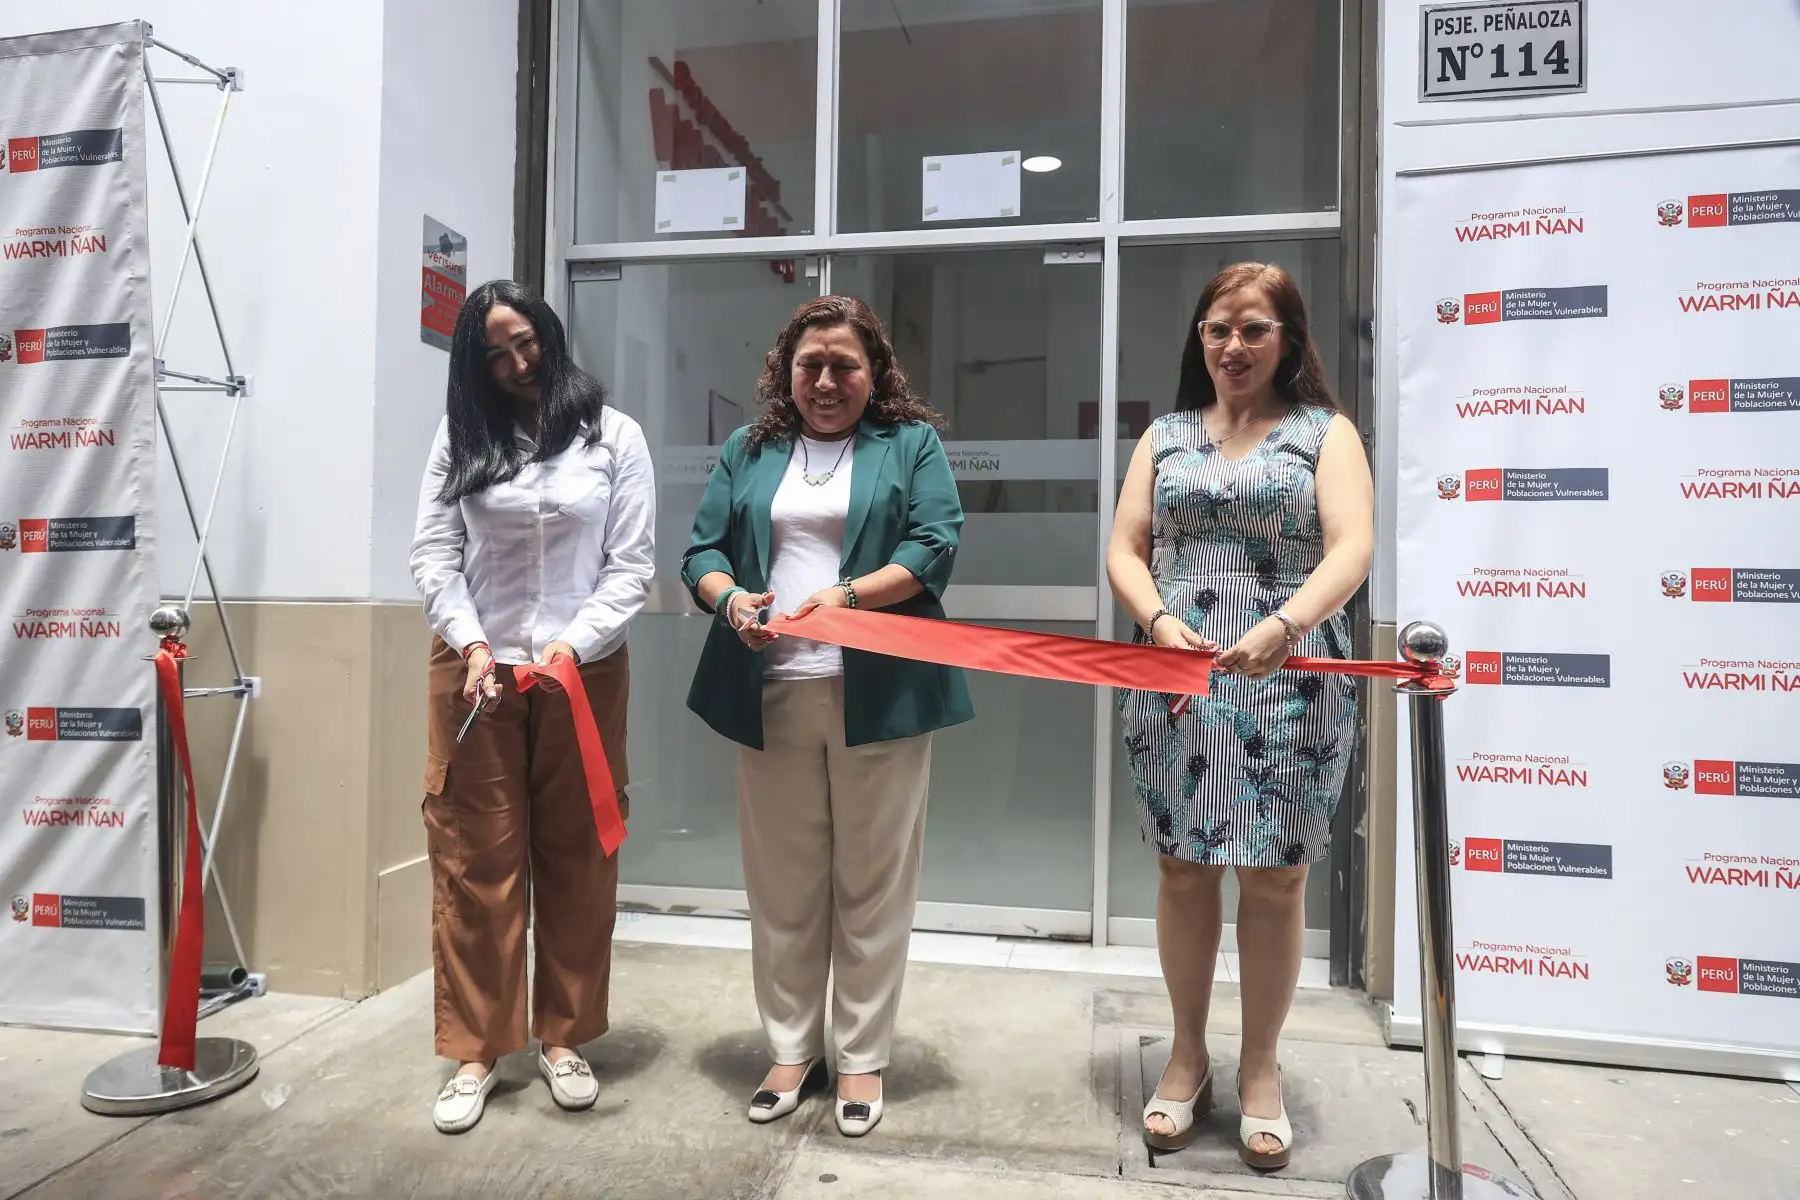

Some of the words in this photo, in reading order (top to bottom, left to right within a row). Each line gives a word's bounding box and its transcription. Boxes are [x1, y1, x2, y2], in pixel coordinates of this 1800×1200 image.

[1434, 16, 1478, 36] PSJE.
[1484, 8, 1572, 32] PEÑALOZA
[41, 136, 72, 146] Ministerio
[12, 146, 36, 160] PERÚ
[56, 145, 76, 154] Mujer
[41, 154, 79, 165] Poblaciones
[79, 151, 119, 161] Vulnerables
[1732, 194, 1778, 203] Ministerio
[1471, 210, 1520, 221] Programa
[1522, 206, 1566, 216] Nacional
[1692, 203, 1723, 216] PERÚ
[1732, 205, 1743, 213] de
[1756, 202, 1783, 212] Mujer
[1732, 211, 1786, 221] Poblaciones
[15, 227, 56, 238] Programa
[57, 224, 91, 234] Nacional
[1455, 221, 1530, 242] WARMI
[1536, 215, 1584, 235] ÑAN
[3, 239, 67, 260] WARMI
[71, 234, 107, 256] ÑAN
[427, 250, 464, 275] verisure
[424, 274, 467, 305] Alarma
[1697, 282, 1749, 291] Programa
[1752, 277, 1800, 288] Nacional
[1506, 292, 1546, 300] Ministerio
[1678, 293, 1760, 312] WARMI
[1767, 287, 1800, 309] ÑA
[1468, 300, 1497, 314] PERÚ
[1518, 300, 1526, 308] la
[1527, 300, 1551, 309] Mujer
[1506, 308, 1553, 317] Poblaciones
[1554, 307, 1603, 315] Vulnerables
[47, 330, 78, 338] Ministerio
[19, 339, 43, 351] PERÚ
[61, 339, 83, 347] Mujer
[84, 339, 89, 347] y
[46, 348, 86, 357] Poblaciones
[86, 346, 127, 354] Vulnerables
[1472, 387, 1521, 397] Programa
[1524, 385, 1567, 394] Nacional
[1734, 382, 1779, 390] Ministerio
[1693, 389, 1725, 401] PERÚ
[1734, 391, 1745, 399] de
[1747, 391, 1755, 399] la
[1757, 391, 1784, 399] Mujer
[1786, 391, 1793, 399] y
[1456, 399, 1530, 418] WARMI
[1536, 395, 1585, 415] ÑAN
[1734, 400, 1787, 408] Poblaciones
[21, 419, 61, 429] Programa
[63, 416, 98, 426] Nacional
[10, 431, 71, 451] WARMI
[75, 427, 115, 447] ÑAN
[969, 456, 999, 471] ÑAN
[1698, 468, 1751, 478] Programa
[1754, 468, 1800, 477] Naciona
[1469, 478, 1499, 490] PERÚ
[1507, 480, 1517, 488] de
[1518, 480, 1526, 488] la
[1527, 481, 1551, 490] Mujer
[1680, 482, 1761, 499] WARMI
[1768, 477, 1800, 499] ÑA
[1507, 489, 1554, 497] Poblaciones
[1556, 489, 1604, 497] Vulnerables
[23, 529, 45, 541] PERÚ
[50, 531, 59, 539] de
[69, 531, 92, 539] Mujer
[50, 539, 94, 547] Poblaciones
[1473, 567, 1521, 578] Programa
[1524, 568, 1568, 577] Nacional
[1736, 572, 1781, 580] Ministerio
[1456, 580, 1530, 598] WARMI
[1536, 577, 1586, 598] ÑAN
[1695, 577, 1727, 590] PERÚ
[1759, 582, 1787, 591] Mujer
[1788, 583, 1794, 591] y
[1737, 591, 1789, 599] Poblaciones
[26, 609, 70, 618] Programa
[71, 608, 105, 616] Nacional
[12, 621, 76, 640] WARMI
[80, 617, 120, 638] ÑAN
[1506, 656, 1548, 664] Ministerio
[1700, 658, 1754, 669] Programa
[1757, 659, 1800, 670] Naciona
[1469, 661, 1498, 673] PERÚ
[1506, 664, 1517, 672] de
[1518, 665, 1526, 673] la
[1528, 665, 1553, 674] Mujer
[1506, 673, 1555, 682] Poblaciones
[1557, 675, 1606, 684] Vulnerables
[1683, 671, 1765, 691] WARMI
[1771, 670, 1800, 692] ÑA
[29, 717, 54, 729] PERÚ
[1472, 752, 1521, 763] Programa
[1525, 754, 1569, 764] Nacional
[1456, 765, 1532, 785] WARMI
[1538, 764, 1587, 787] ÑAN
[1739, 765, 1785, 775] Ministerio
[1698, 770, 1730, 783] PERÚ
[1739, 775, 1751, 783] de
[1753, 775, 1761, 783] la
[1763, 776, 1791, 786] Mujer
[1792, 779, 1798, 787] y
[1740, 785, 1793, 794] Poblaciones
[23, 809, 84, 826] WARMI
[88, 806, 124, 828] ÑAN
[1507, 843, 1549, 853] Ministerio
[1468, 848, 1499, 861] PERÚ
[1507, 852, 1518, 860] de
[1519, 853, 1527, 861] la
[1529, 854, 1554, 864] Mujer
[1555, 856, 1561, 864] y
[1704, 852, 1757, 864] Programa
[1760, 856, 1800, 866] Nacion
[1507, 862, 1556, 872] Poblaciones
[1558, 864, 1608, 875] Vulnerables
[1685, 866, 1768, 887] WARMI
[34, 904, 58, 916] PERÚ
[1472, 940, 1523, 952] Programa
[1525, 944, 1571, 956] Nacional
[1456, 953, 1533, 976] WARMI
[1539, 955, 1588, 980] ÑAN
[1743, 963, 1789, 974] Ministerio
[1701, 968, 1733, 980] PERÚ
[1743, 973, 1754, 981] de
[1767, 975, 1794, 985] Mujer
[1743, 982, 1797, 993] Poblaciones
